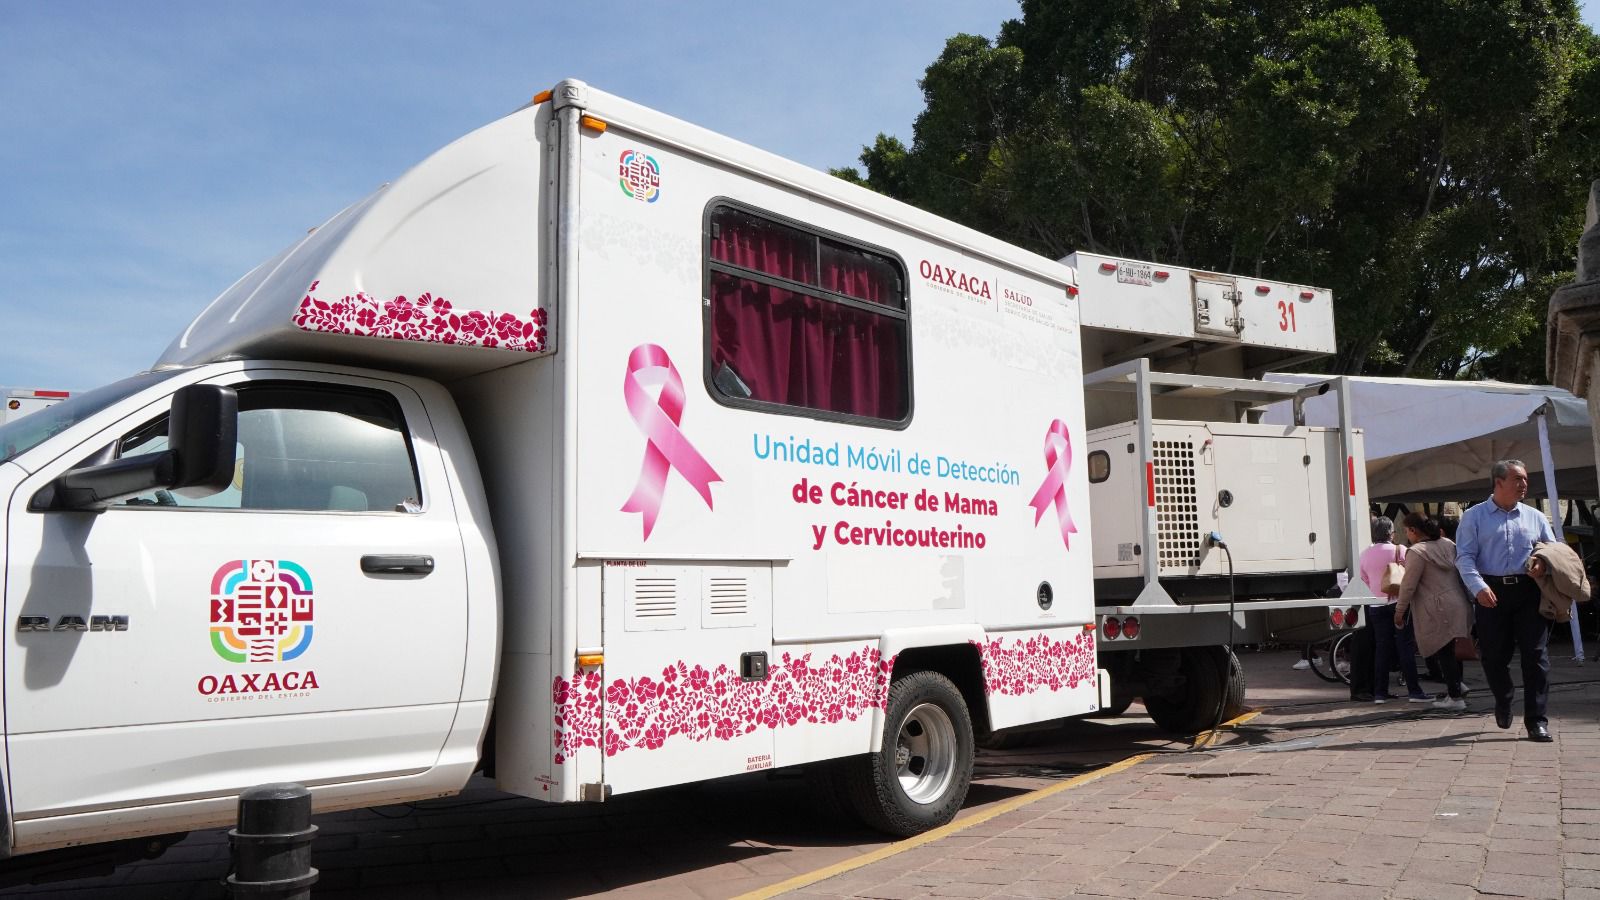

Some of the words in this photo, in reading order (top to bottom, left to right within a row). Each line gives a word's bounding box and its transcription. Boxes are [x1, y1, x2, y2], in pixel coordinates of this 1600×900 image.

[920, 260, 992, 300] OAXACA
[1004, 288, 1032, 307] SALUD
[1278, 300, 1297, 333] 31
[753, 433, 839, 467] Unidad
[847, 444, 901, 473] Móvil
[907, 452, 931, 476] de
[937, 456, 1020, 486] Detección
[792, 477, 823, 504] de
[830, 481, 909, 510] Cáncer
[914, 488, 939, 512] de
[944, 492, 998, 516] Mama
[812, 524, 827, 550] y
[834, 520, 986, 549] Cervicouterino
[17, 615, 129, 632] RAM
[198, 670, 320, 696] OAXACA
